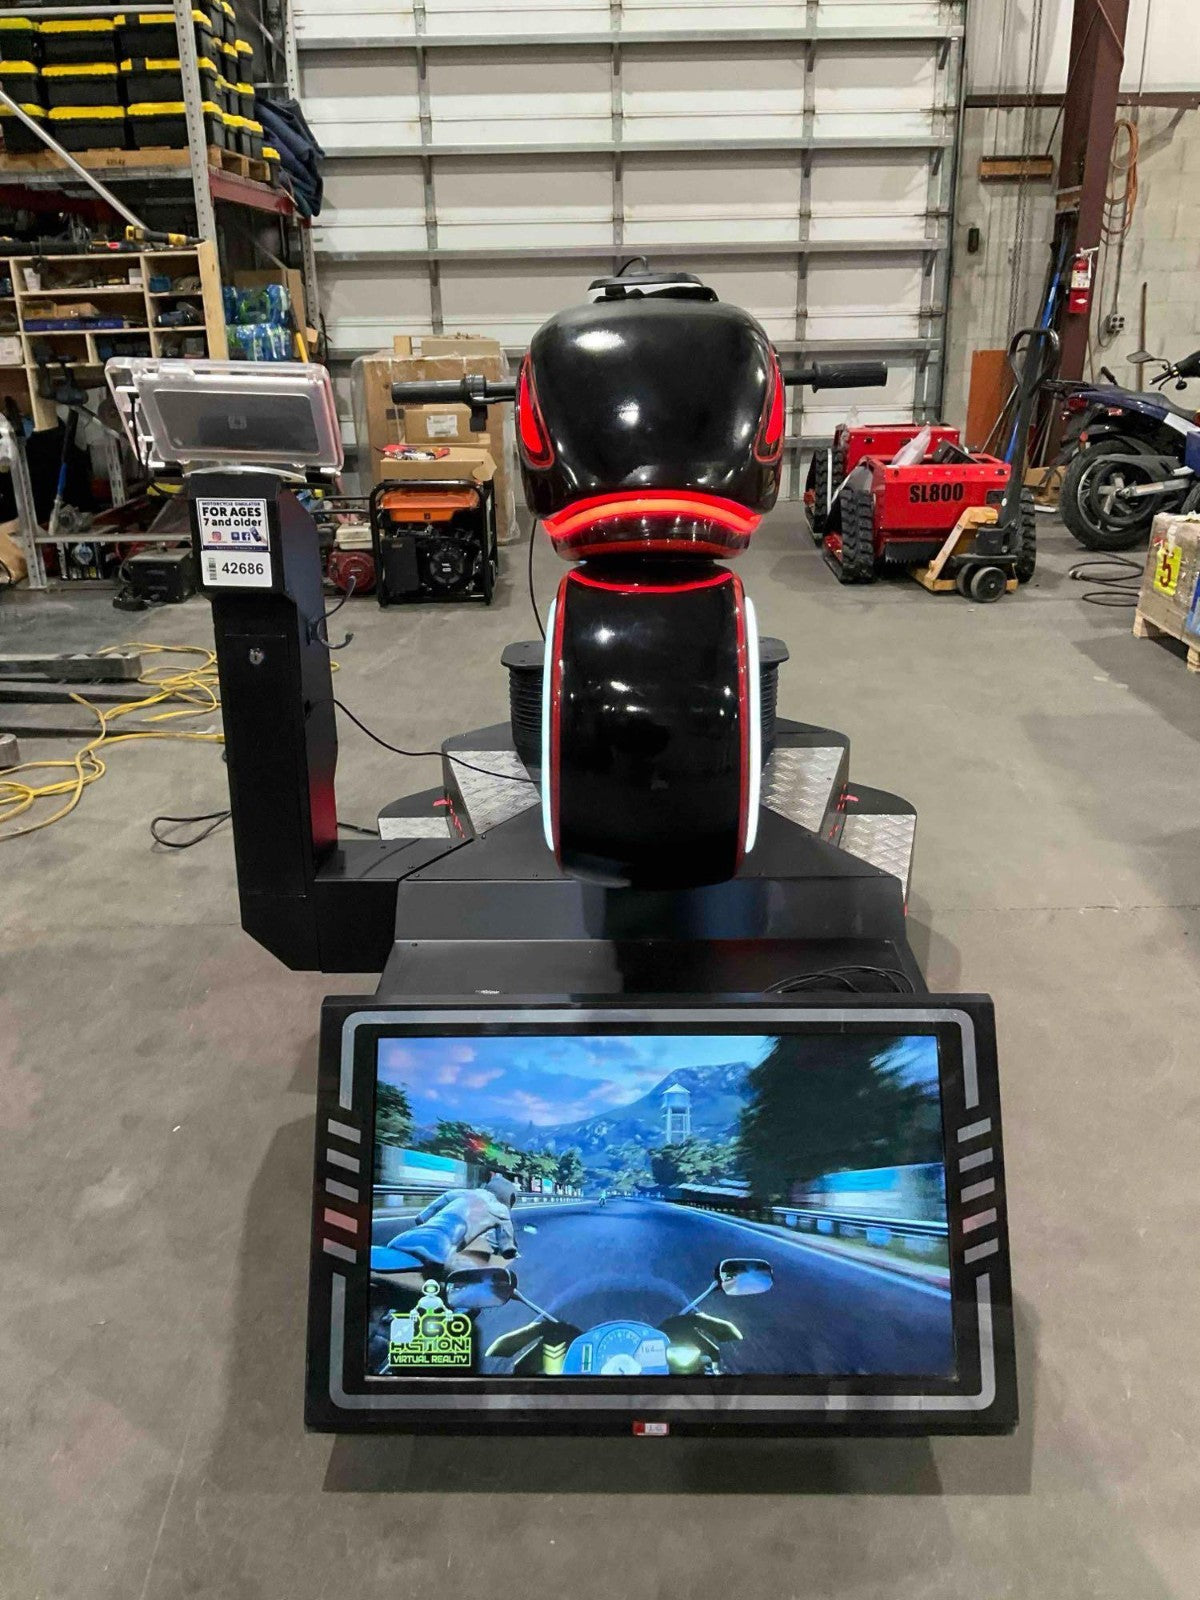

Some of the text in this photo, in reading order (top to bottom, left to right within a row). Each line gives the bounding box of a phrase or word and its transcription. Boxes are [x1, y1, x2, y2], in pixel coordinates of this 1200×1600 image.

[909, 483, 964, 503] SL800
[203, 507, 261, 517] FOR AGES
[204, 518, 261, 527] 7 and older
[222, 562, 264, 575] 42686
[394, 1355, 467, 1363] VIRTUAL REALITY
